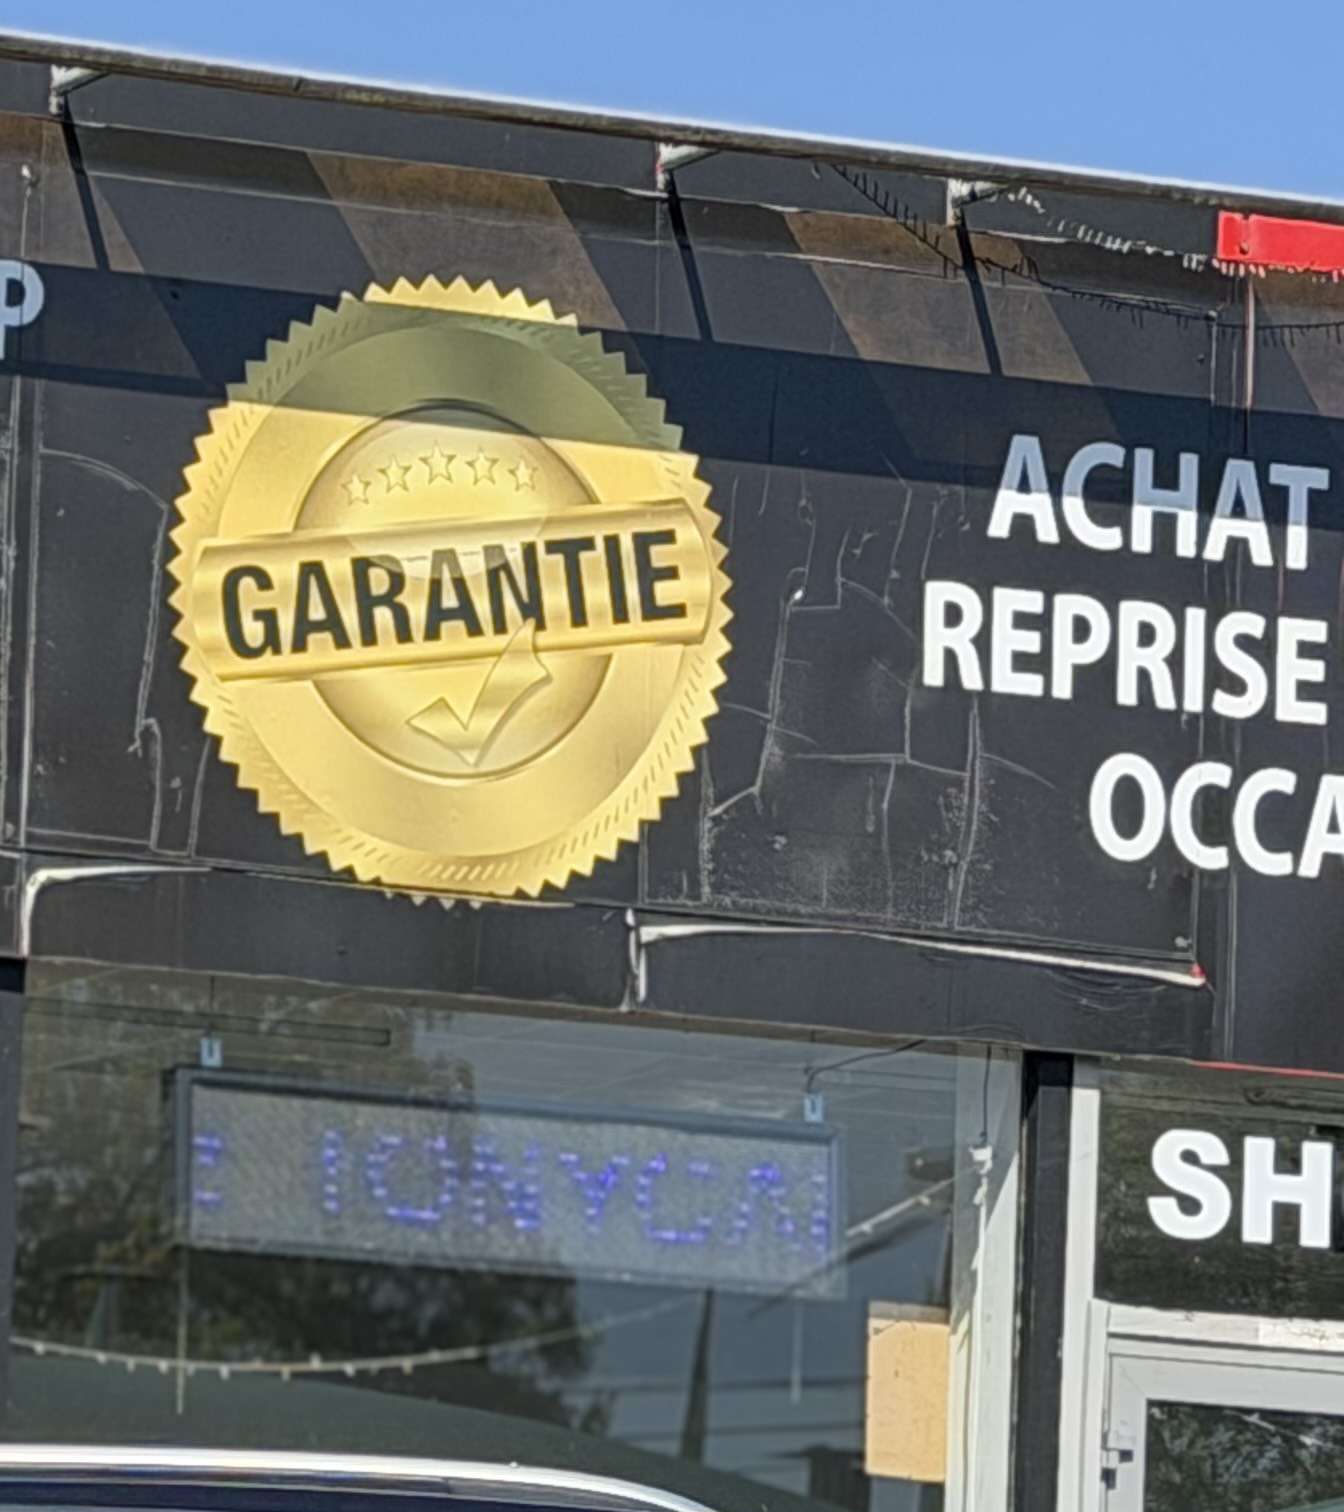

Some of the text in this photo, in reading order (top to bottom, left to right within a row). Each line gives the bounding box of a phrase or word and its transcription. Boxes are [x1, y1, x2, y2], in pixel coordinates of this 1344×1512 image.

[986, 434, 1330, 570] ACHAT
[220, 527, 689, 660] GARANTIE
[923, 580, 1328, 726] REPRISE
[1089, 752, 1344, 878] OCCA
[1147, 1128, 1332, 1249] SH
